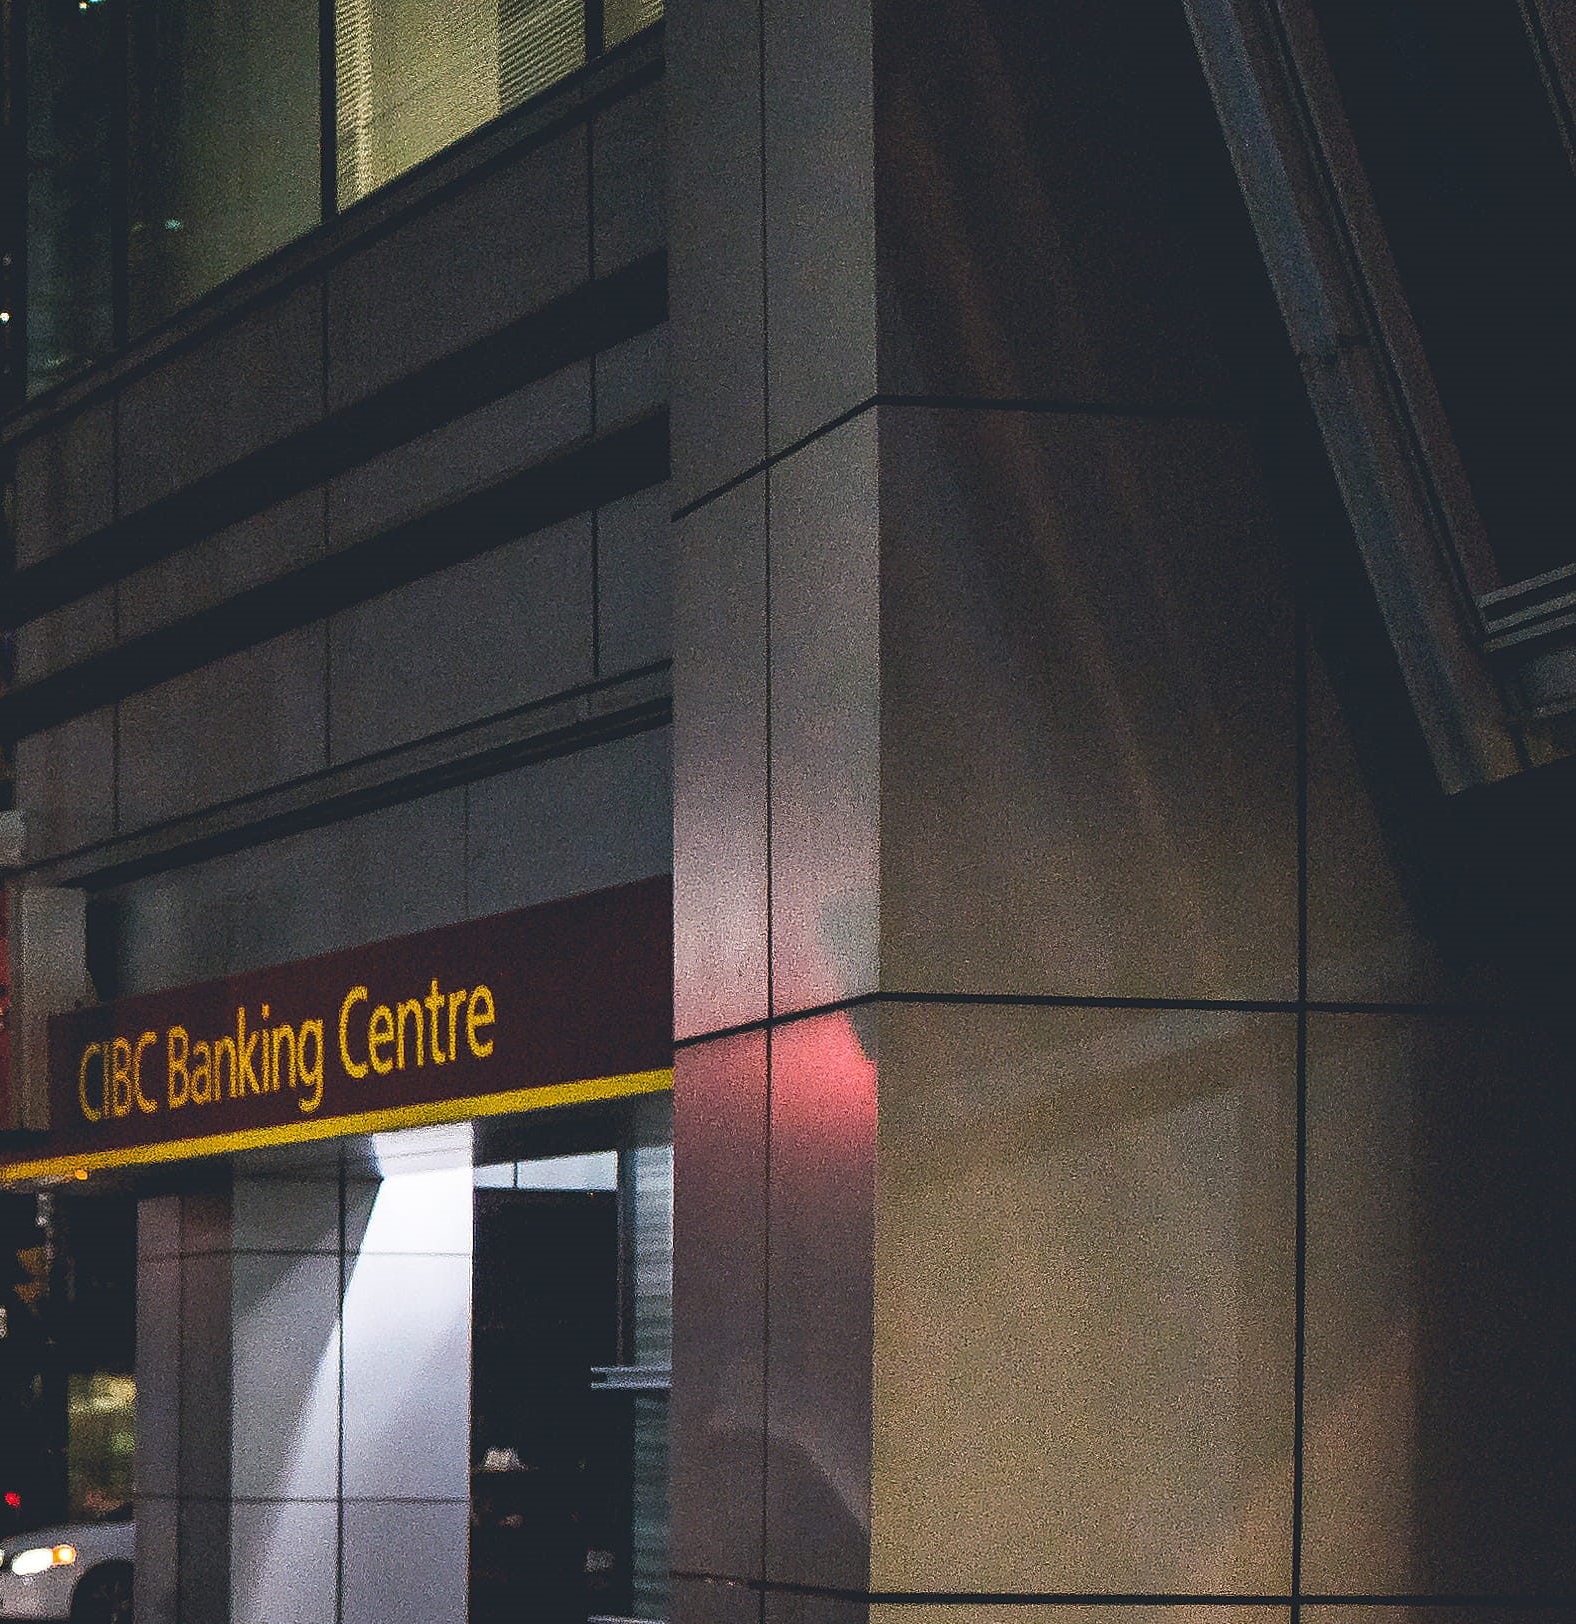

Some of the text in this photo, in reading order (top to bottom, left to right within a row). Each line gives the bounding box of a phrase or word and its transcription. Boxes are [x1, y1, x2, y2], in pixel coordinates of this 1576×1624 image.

[78, 976, 497, 1123] CIBC Banking Centre
